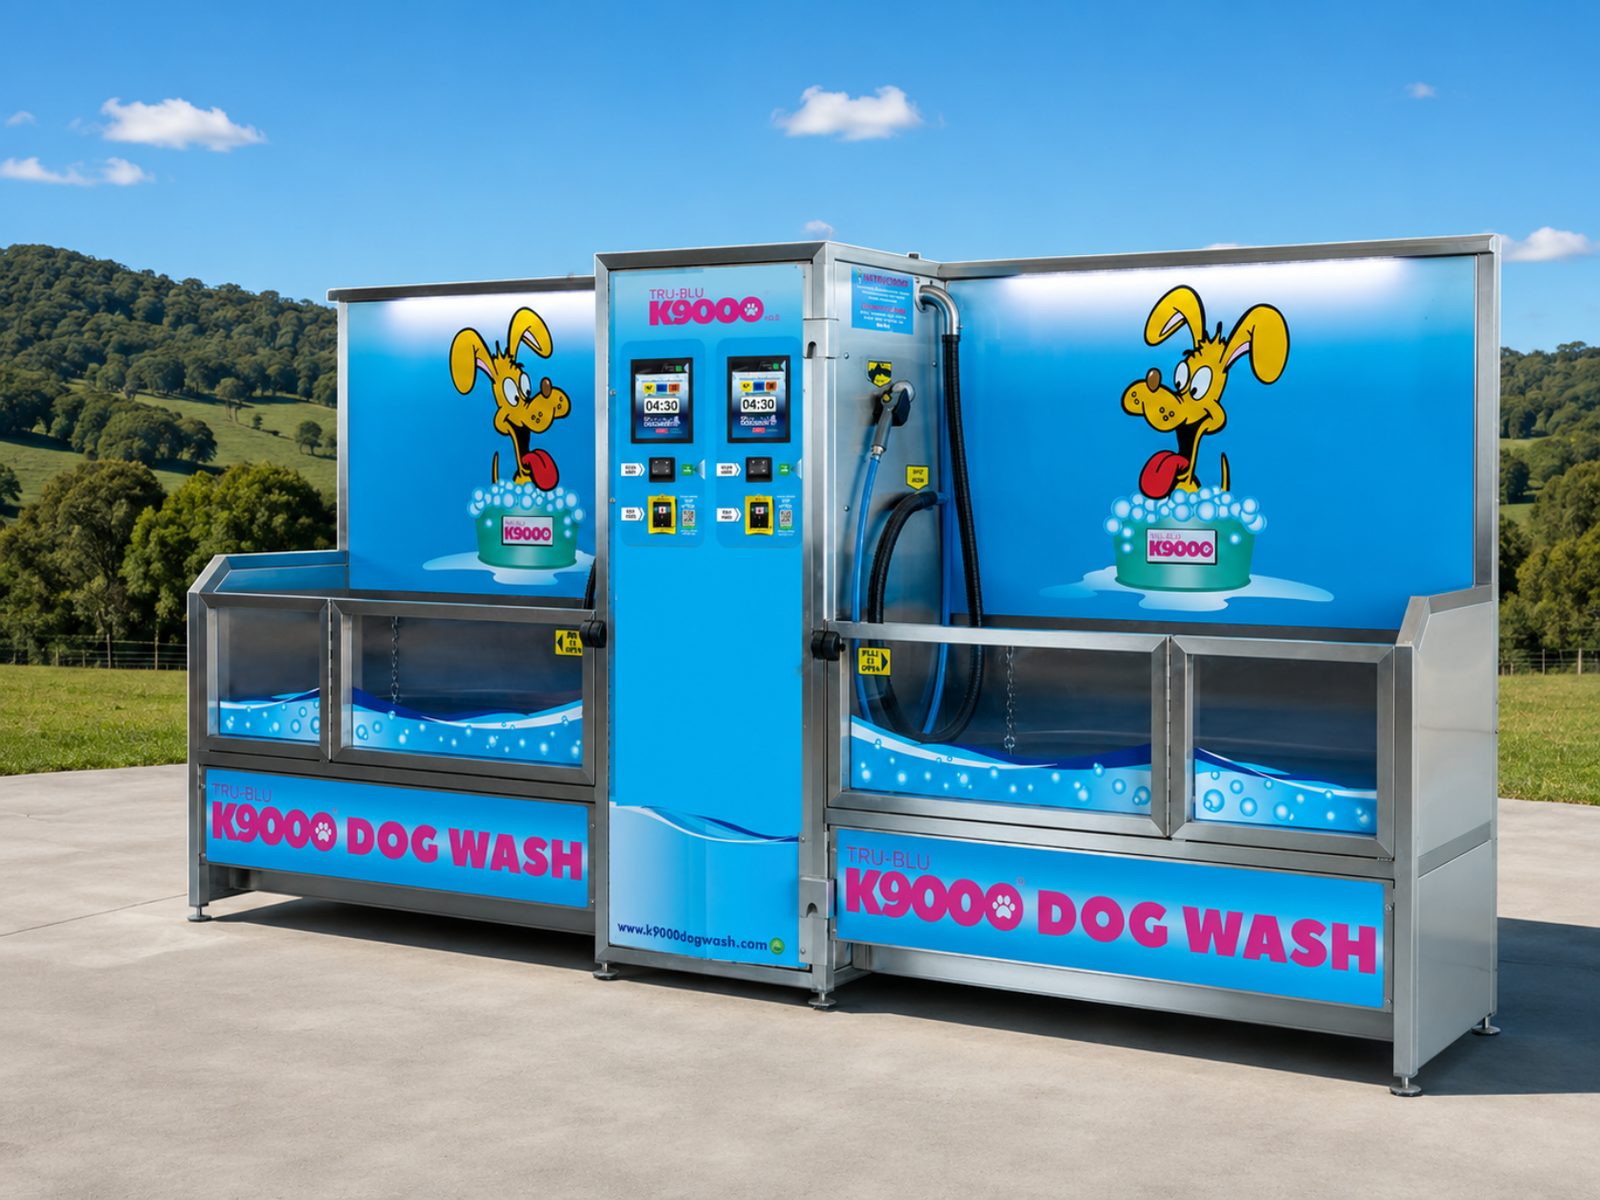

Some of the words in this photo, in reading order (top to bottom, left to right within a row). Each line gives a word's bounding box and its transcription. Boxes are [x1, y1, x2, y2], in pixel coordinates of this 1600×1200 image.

[649, 296, 764, 326] K9000
[645, 400, 678, 412] 04:30
[742, 398, 775, 410] 04:30
[504, 526, 552, 541] K9000
[1149, 540, 1214, 558] K9000
[211, 782, 273, 803] TRU-BLU
[211, 801, 338, 852] K9000
[347, 817, 439, 864] DOG
[449, 828, 583, 881] WASH
[846, 845, 931, 870] TRU-BLU
[845, 867, 1024, 932] K9000
[1038, 889, 1168, 949] DOG
[1183, 905, 1377, 975] WASH
[617, 923, 768, 951] www.k9000dogwash.com
